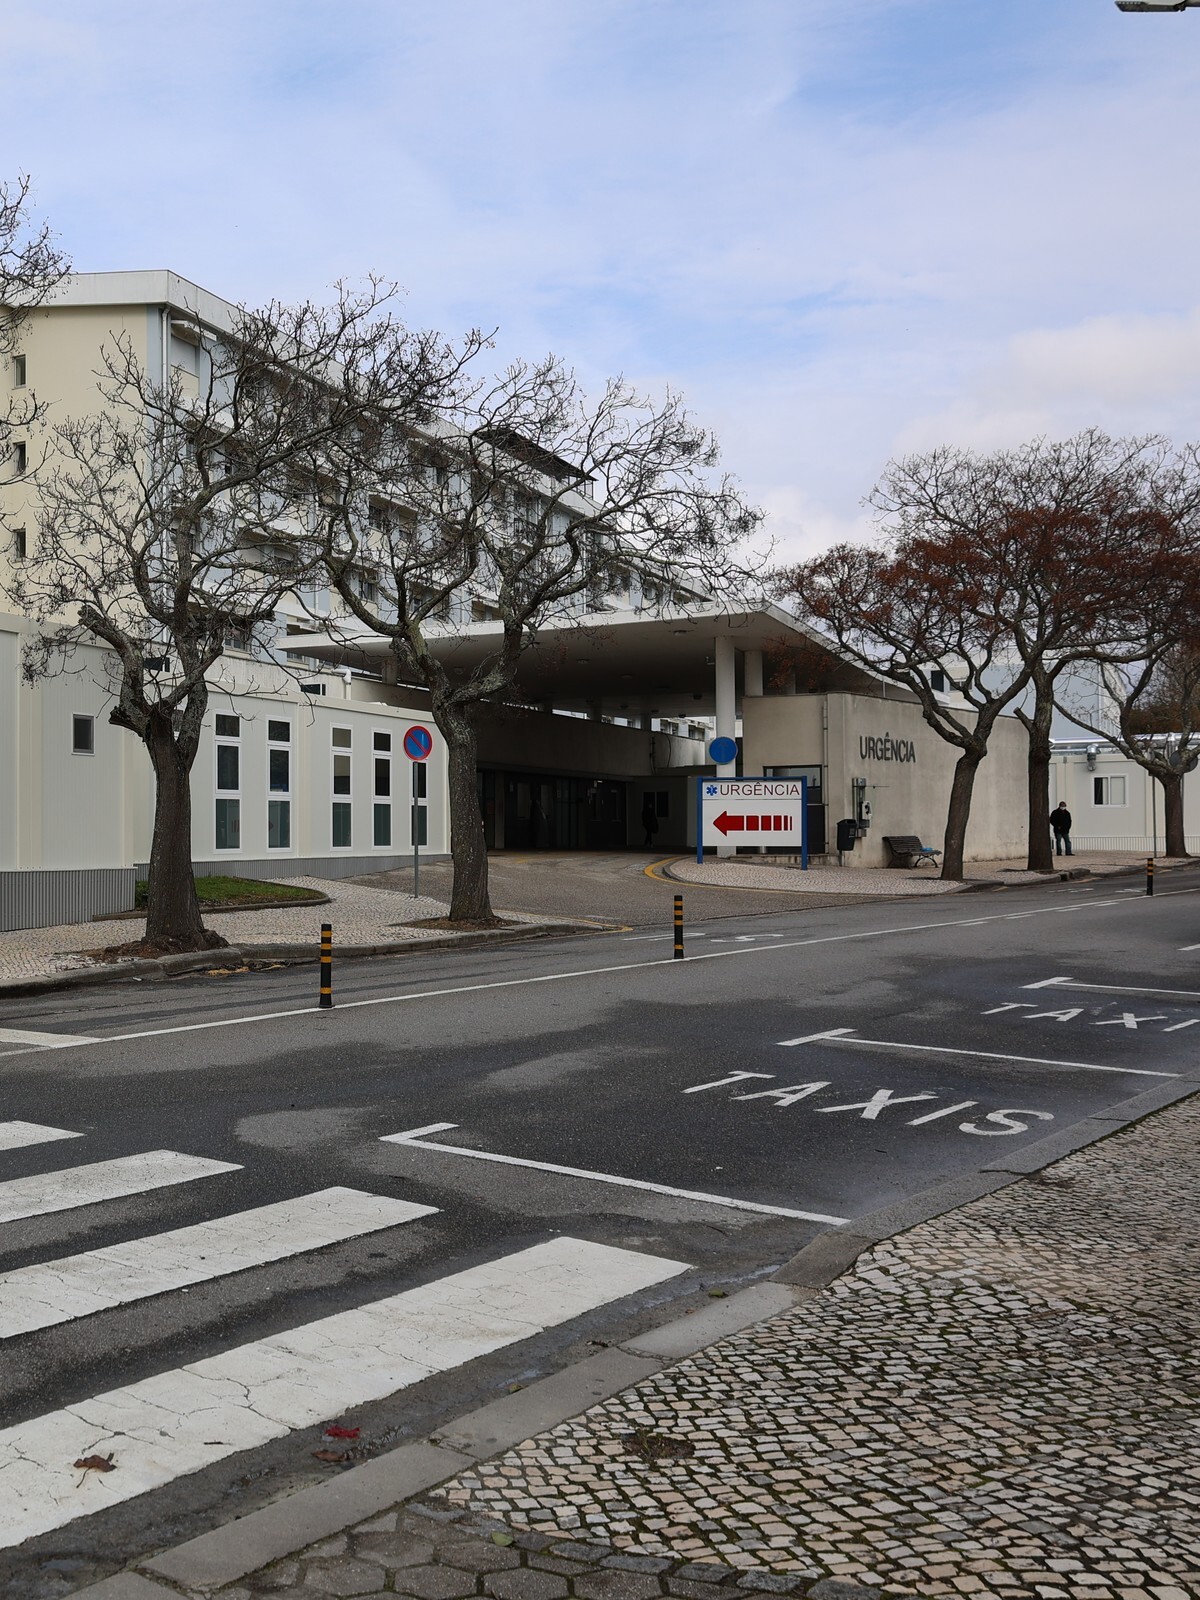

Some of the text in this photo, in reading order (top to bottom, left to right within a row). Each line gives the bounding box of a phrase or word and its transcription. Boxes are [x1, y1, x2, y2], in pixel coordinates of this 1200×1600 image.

[859, 732, 916, 763] URGÊNCIA
[719, 782, 800, 796] URGÊNCIA
[679, 1070, 1055, 1136] TAXIS
